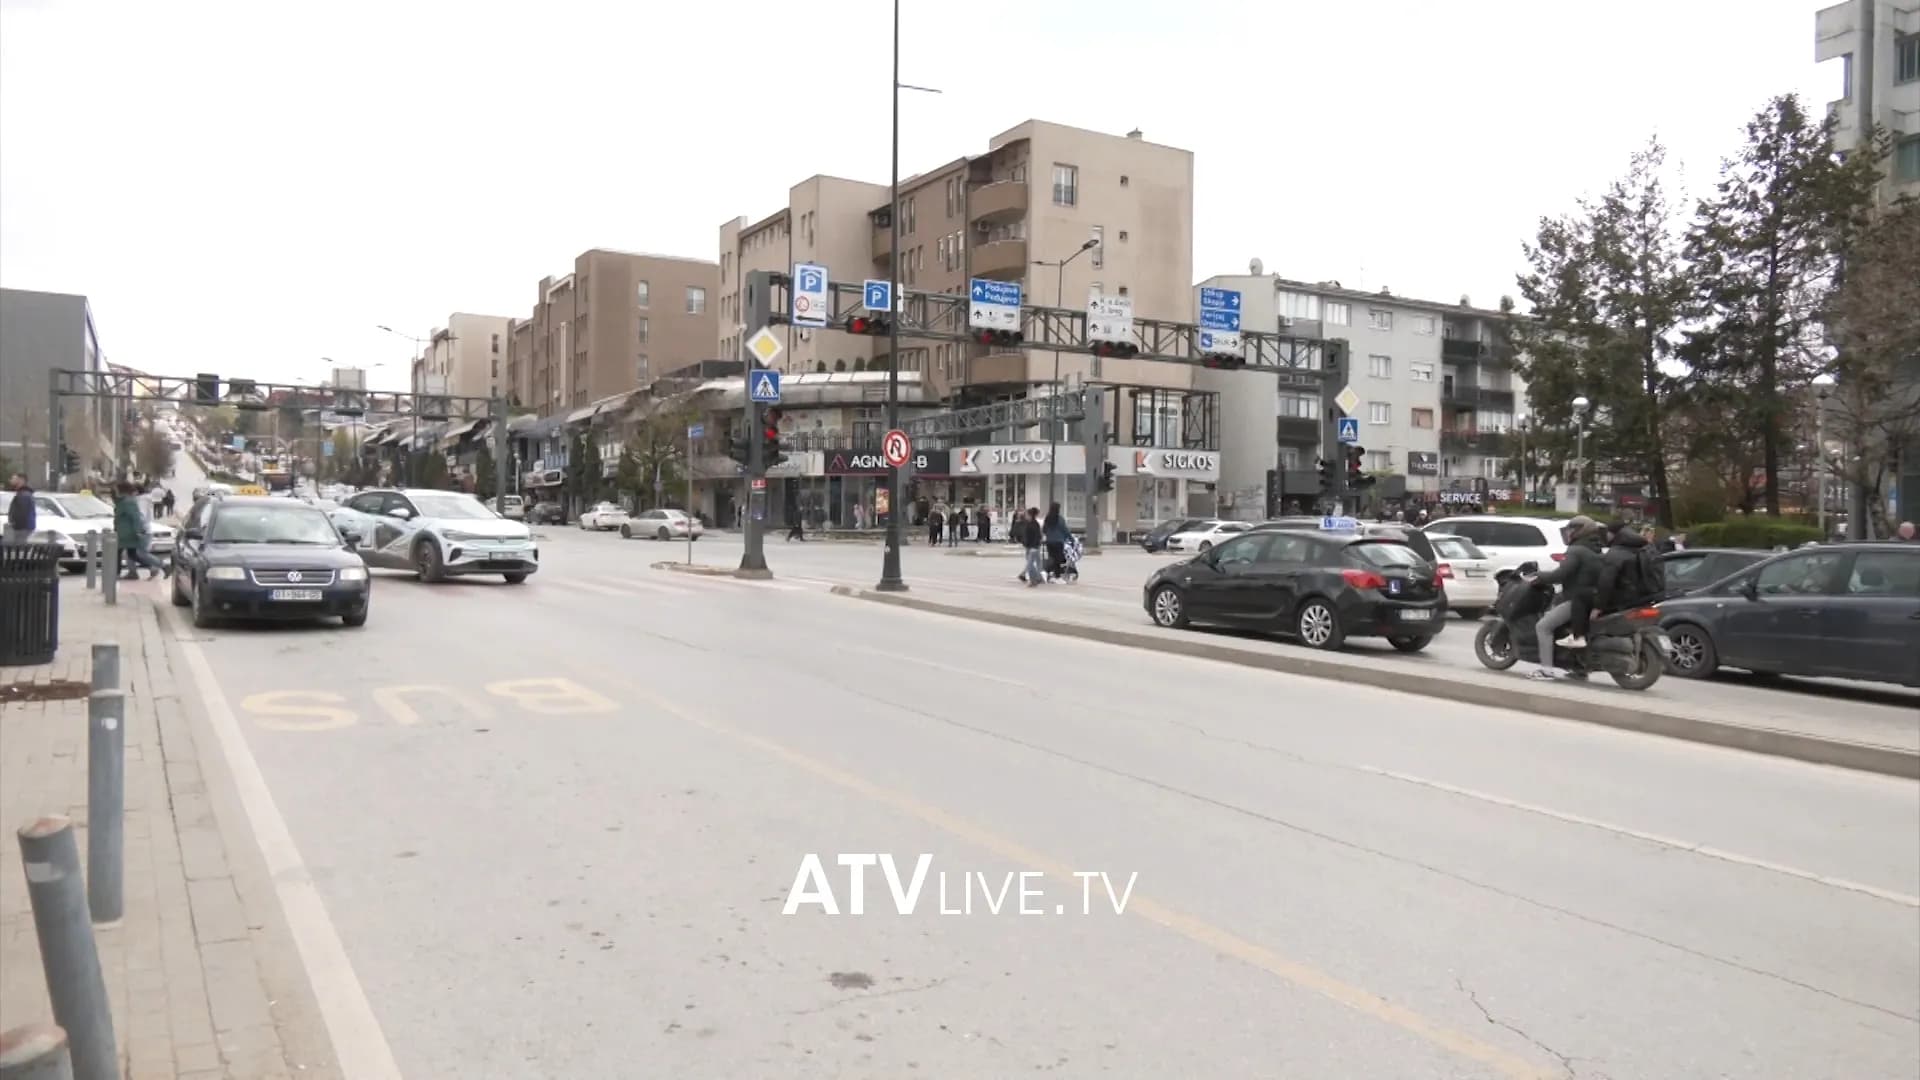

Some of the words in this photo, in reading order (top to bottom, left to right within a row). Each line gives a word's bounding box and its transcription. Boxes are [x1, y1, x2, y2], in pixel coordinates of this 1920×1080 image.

[1163, 453, 1215, 471] SIGKOS
[1440, 492, 1481, 505] SERVICE
[240, 677, 622, 732] BUS
